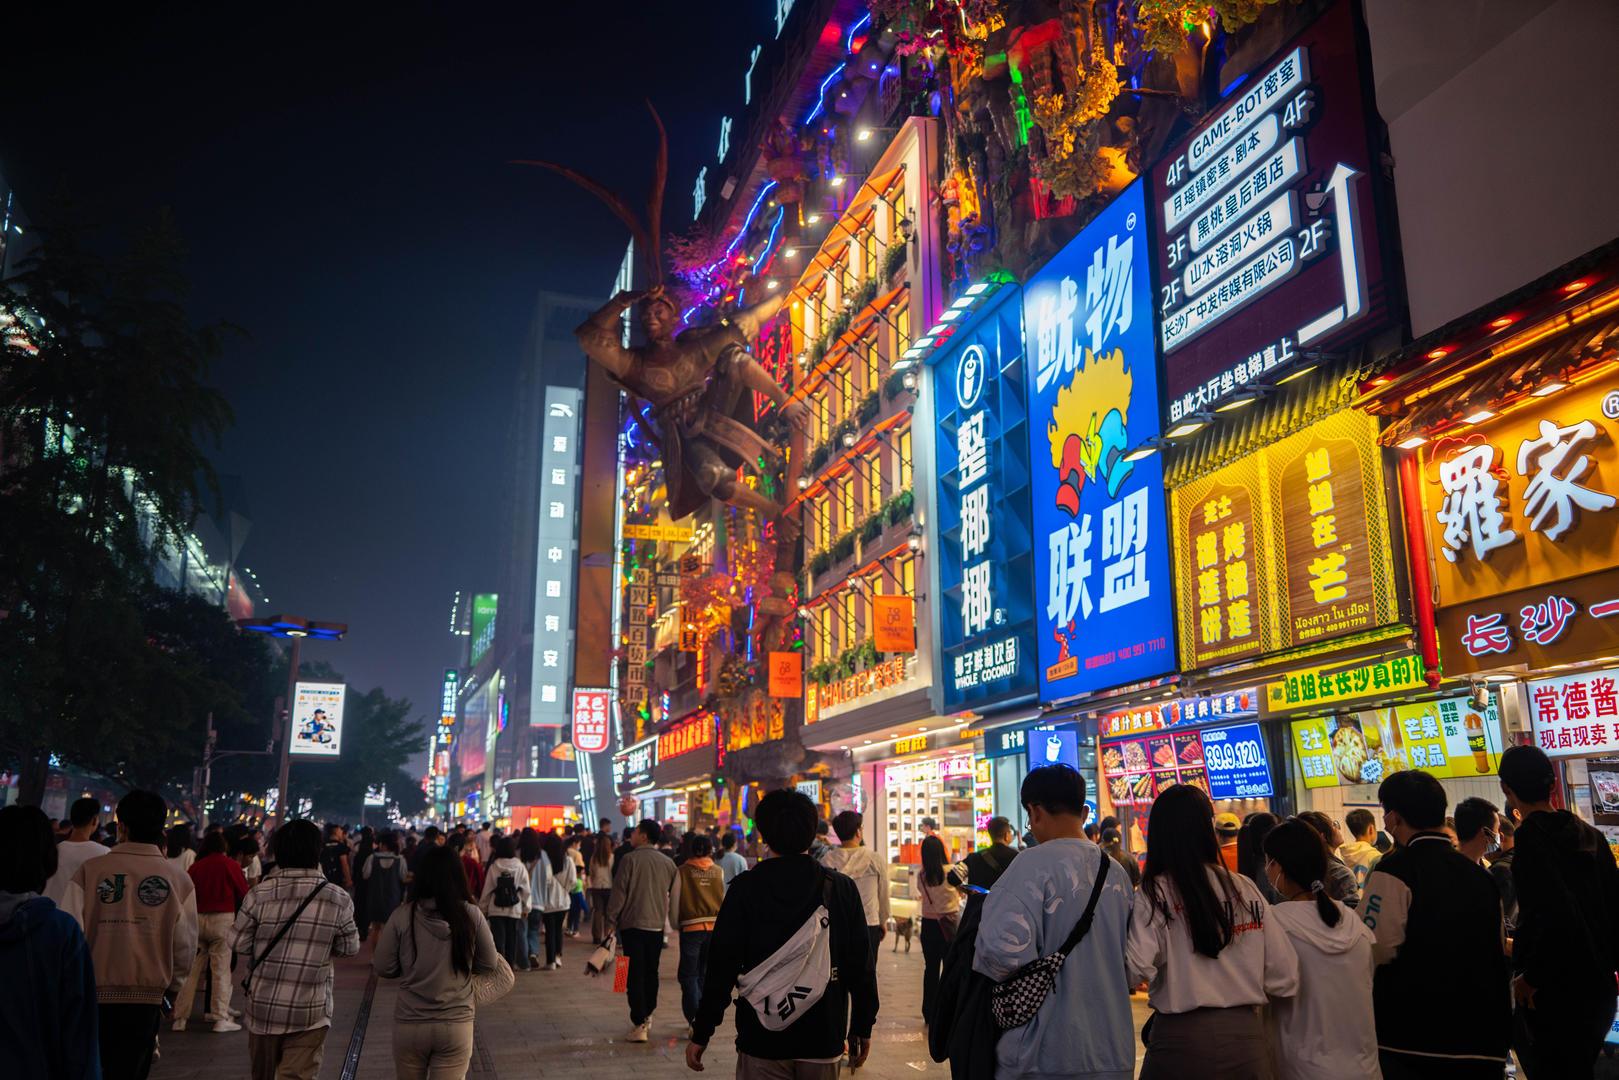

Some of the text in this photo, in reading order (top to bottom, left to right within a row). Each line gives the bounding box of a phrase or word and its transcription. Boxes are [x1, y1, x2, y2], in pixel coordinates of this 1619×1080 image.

[1193, 58, 1294, 159] GAME-BOT密室
[1283, 91, 1309, 128] 4F
[1165, 155, 1185, 187] 4F
[1197, 155, 1284, 242] 黑桃皇后酒店
[1166, 234, 1186, 269] 3F
[1190, 211, 1273, 285] 山水溶洞火锅
[1299, 218, 1325, 259] 2F
[1161, 278, 1180, 312] 2F
[1164, 243, 1293, 342] 长沙广中发传媒有限公司
[1170, 336, 1294, 423] 由此大厅坐电梯直上
[1305, 447, 1348, 604] 姐姐在芒
[1047, 486, 1150, 629] 联盟
[955, 661, 1016, 690] WHOLE COCONUT
[1404, 715, 1440, 740] 芒果
[1539, 723, 1608, 750] 现卤现卖
[1410, 744, 1447, 769] 饮品
